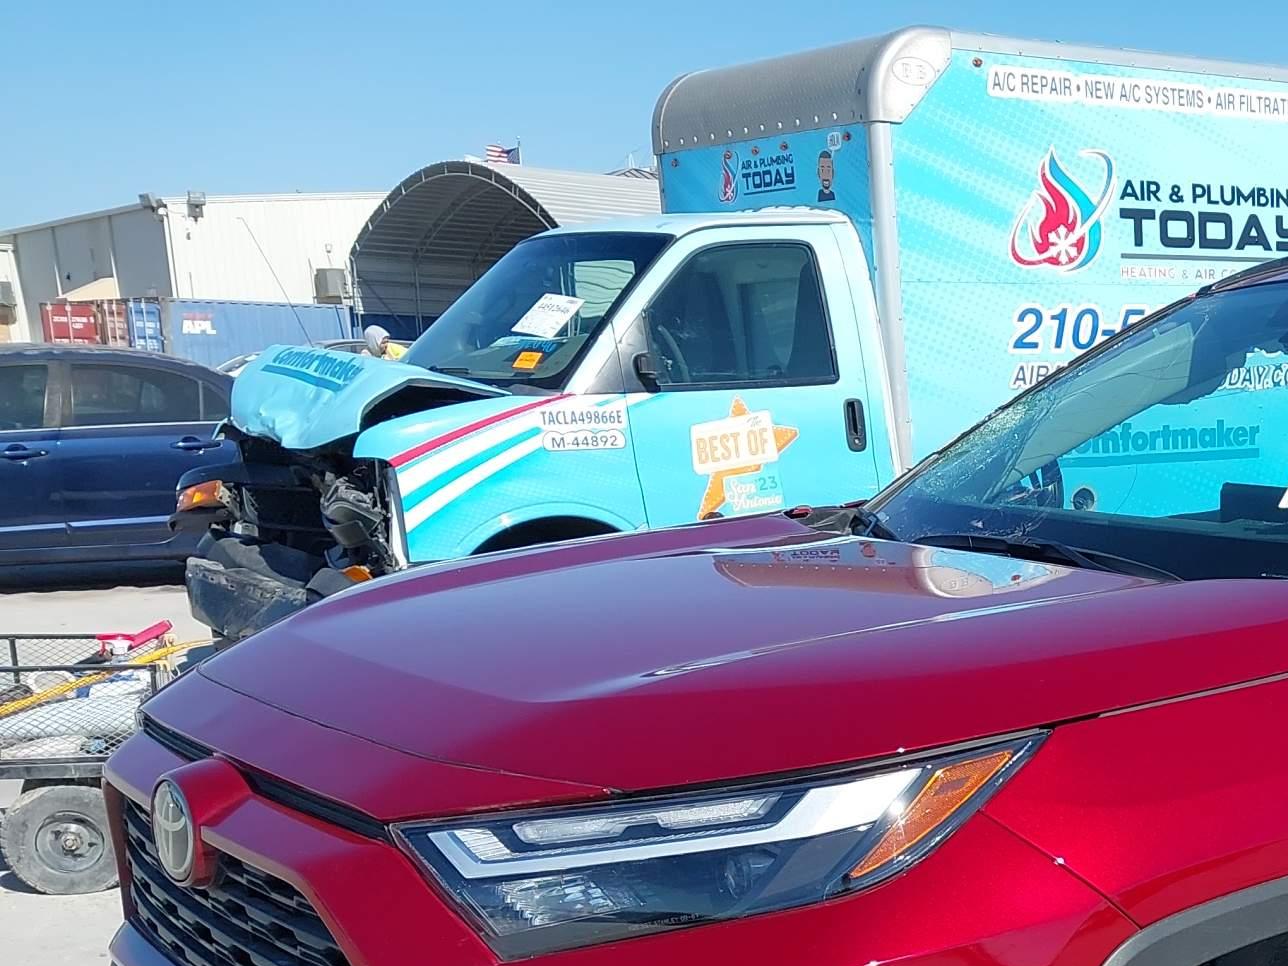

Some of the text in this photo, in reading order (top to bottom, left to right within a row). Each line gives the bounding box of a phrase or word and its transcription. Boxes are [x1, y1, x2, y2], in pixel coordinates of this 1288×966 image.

[992, 71, 1016, 92] A/C
[1020, 74, 1073, 96] REPAIR
[1085, 79, 1115, 100] NEW
[1119, 83, 1147, 103] A/C
[1144, 84, 1205, 109] SYSTEMS
[1215, 92, 1236, 111] AIR
[742, 166, 796, 190] TODAY
[1119, 179, 1162, 202] AIR
[1168, 184, 1184, 203] &
[1121, 266, 1175, 279] HEATING
[1195, 269, 1216, 280] AIR
[540, 410, 623, 426] TACLA49866E
[551, 434, 619, 449] M-44892
[696, 427, 769, 465] BEST OF
[1073, 419, 1260, 455] omfortmaker
